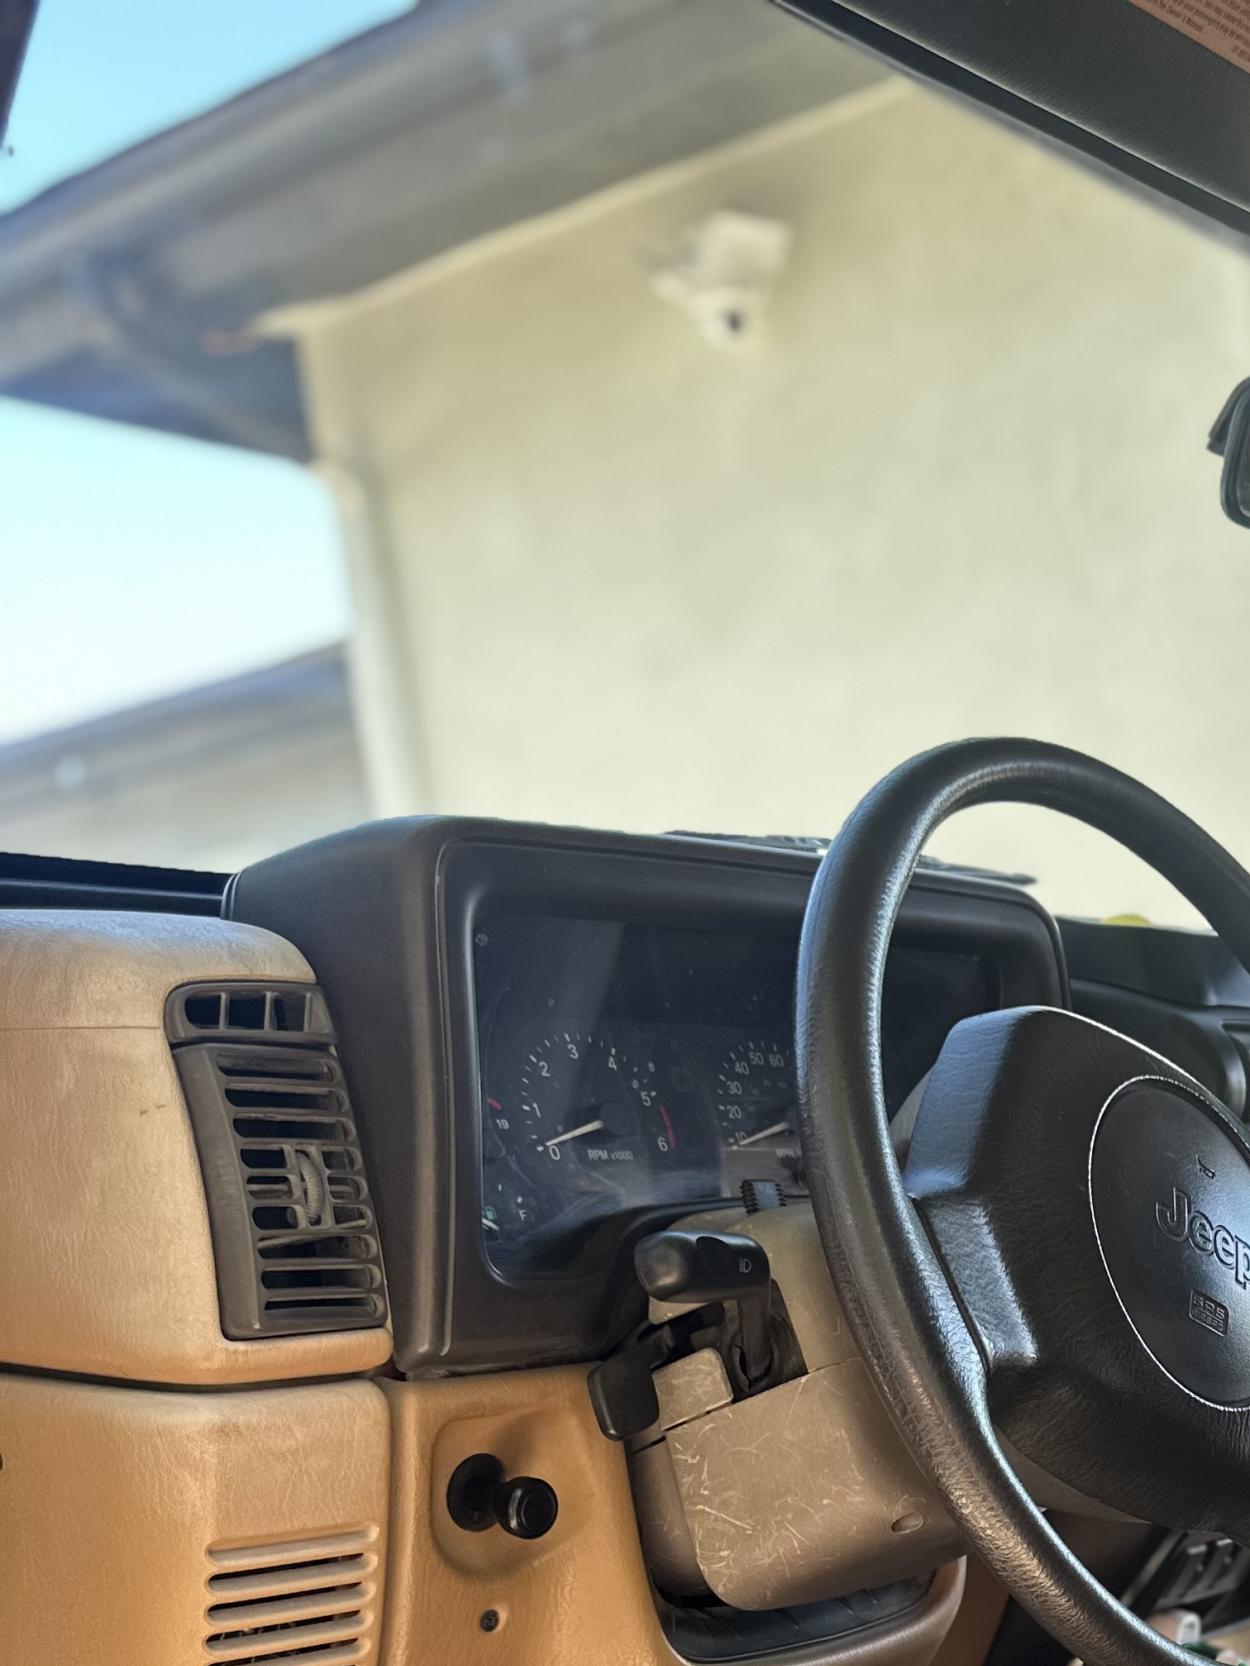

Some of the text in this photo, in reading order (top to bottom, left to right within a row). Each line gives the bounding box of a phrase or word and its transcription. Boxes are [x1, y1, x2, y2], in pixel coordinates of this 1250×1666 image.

[567, 1044, 579, 1060] 3
[749, 1051, 764, 1066] 50
[608, 1056, 617, 1071] 4
[735, 1061, 749, 1075] 40
[768, 1053, 785, 1068] 60
[539, 1061, 550, 1077] 2
[726, 1081, 743, 1095] 30
[641, 1091, 651, 1107] 5
[532, 1102, 541, 1118] 1
[727, 1105, 742, 1119] 20
[496, 1118, 510, 1130] 19
[657, 1136, 668, 1152] 6
[549, 1145, 561, 1161] 0
[518, 1208, 527, 1221] F
